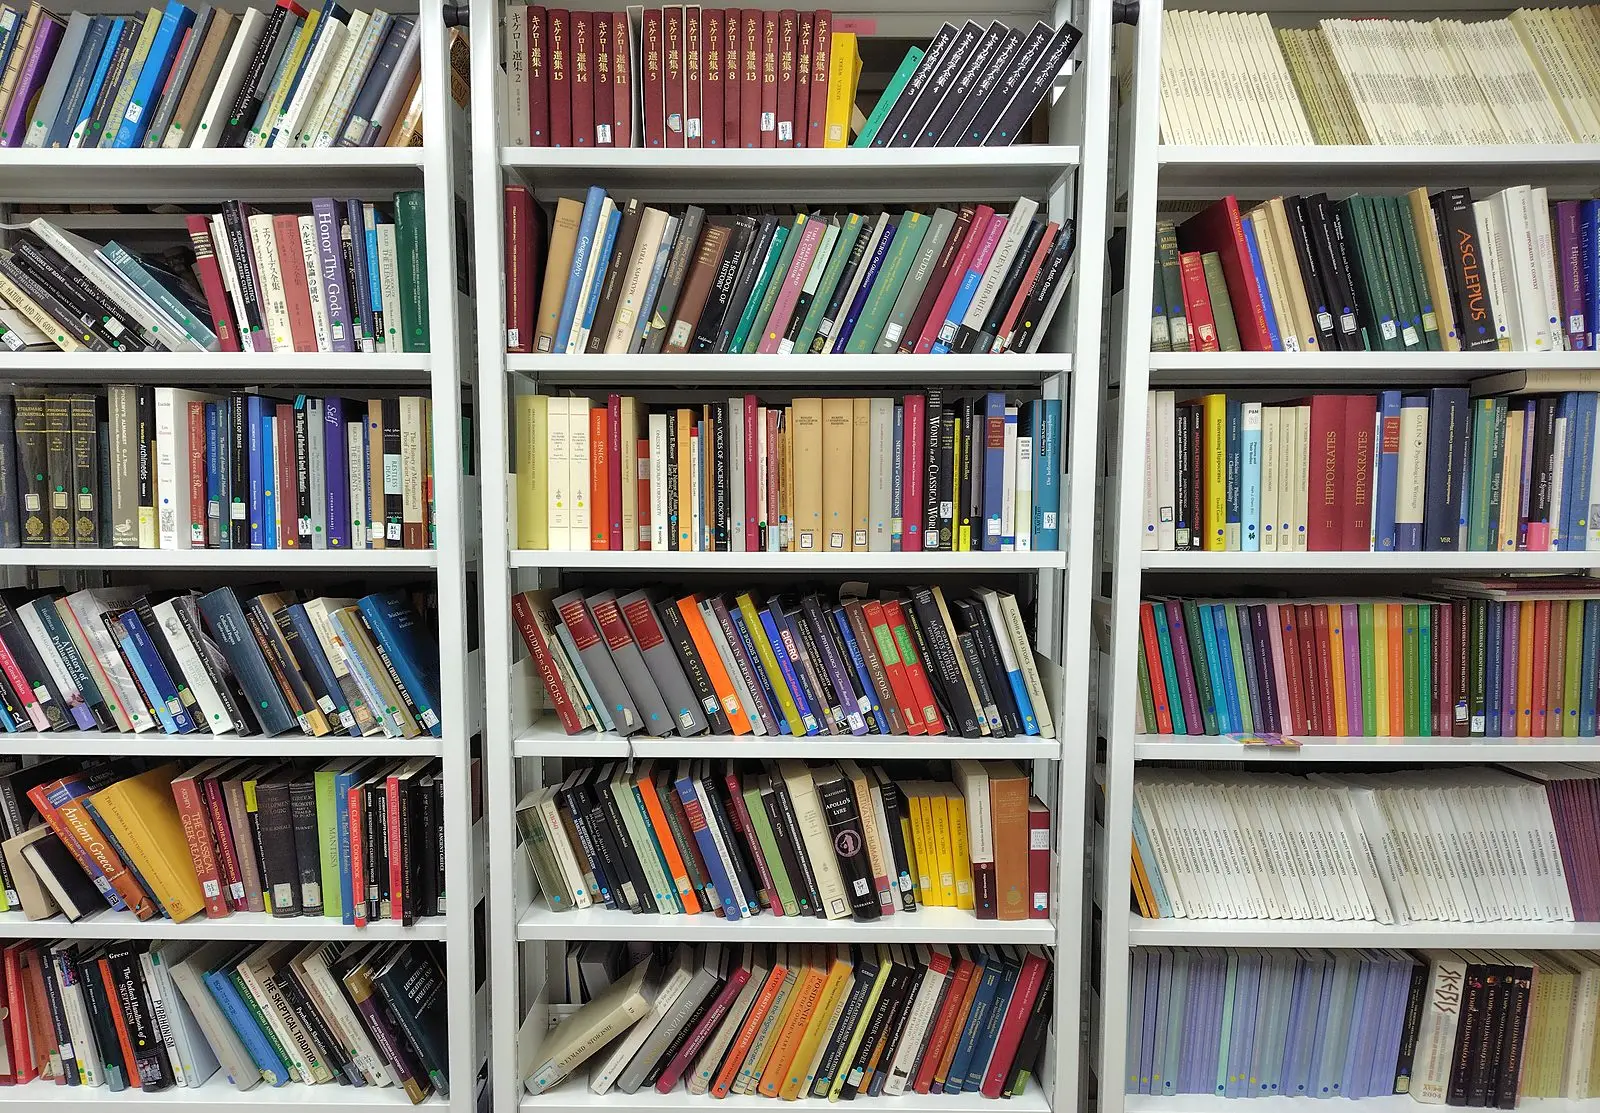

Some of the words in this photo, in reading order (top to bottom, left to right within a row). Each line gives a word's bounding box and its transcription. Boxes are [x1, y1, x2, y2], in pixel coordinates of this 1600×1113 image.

[318, 212, 334, 253] Honor
[21, 243, 46, 268] RELIGIONS
[50, 269, 65, 283] ROME
[321, 251, 337, 280] Thy
[572, 235, 590, 277] Geography
[731, 249, 741, 264] THE
[913, 247, 933, 282] STUDIES
[992, 236, 1014, 275] ANCIENT
[1052, 255, 1062, 269] The
[1570, 245, 1580, 291] Hippocrates
[715, 259, 730, 289] HISTORY
[722, 263, 736, 292] SCHOOL
[964, 273, 976, 291] Irwin
[1046, 268, 1056, 282] Attic
[1456, 227, 1486, 321] ASCLEPIUS
[72, 275, 82, 285] of
[79, 281, 101, 301] Plato's
[98, 297, 126, 324] Academy
[328, 283, 342, 317] Gods
[718, 293, 727, 304] OF
[972, 274, 997, 318] LIBRARIES
[1037, 280, 1051, 302] Orators
[22, 302, 35, 316] AND
[32, 312, 44, 324] THE
[41, 320, 57, 336] GOOD
[325, 404, 337, 426] Self
[929, 416, 939, 447] WOMEN
[717, 450, 723, 459] OF
[1325, 431, 1336, 505] HIPPOKRATES
[1356, 431, 1367, 504] HIPPOKRATES
[927, 464, 938, 505] CLASSICAL
[1538, 483, 1546, 508] Symptoms
[928, 506, 937, 530] WORL
[779, 629, 799, 662] CICERO
[922, 651, 934, 673] SENECA
[929, 619, 945, 650] MARCUS
[940, 649, 958, 684] AURELIUS
[50, 634, 85, 692] Pythagoreanism
[63, 645, 83, 673] History
[78, 670, 88, 682] of
[523, 623, 544, 659] STUDIES
[541, 664, 565, 706] STOICISM
[679, 639, 692, 657] THE
[688, 658, 709, 693] CYNICS
[720, 617, 736, 646] SENECA
[733, 647, 741, 657] IN
[737, 657, 764, 710] PERFORMANCE
[868, 652, 880, 671] THE
[874, 670, 890, 700] STOICS
[191, 811, 202, 829] THE
[826, 797, 850, 810] APOLLO'S
[833, 808, 847, 816] LYRE
[61, 801, 96, 843] Ancient
[88, 839, 118, 874] Greece
[351, 809, 359, 841] CLASSICAL
[856, 784, 873, 833] CULTIVATING
[866, 835, 882, 876] HUMANITY
[180, 813, 195, 842] GREEK
[188, 842, 204, 876] READER
[195, 828, 214, 873] CLASSICAL
[328, 827, 336, 867] MANTISSA
[352, 844, 360, 878] COOKBOOK
[122, 966, 131, 979] The
[767, 968, 784, 993] PLATO'S
[118, 982, 134, 1025] SKEPTICISM
[125, 979, 137, 1000] Oxford
[262, 976, 276, 993] THE
[271, 991, 299, 1032] SKEPTICAL
[760, 991, 772, 1008] FIRST
[774, 989, 785, 1005] From
[796, 976, 823, 1028] POSIDONIUS
[879, 997, 889, 1012] THE
[130, 1001, 144, 1030] Handbook
[153, 998, 174, 1048] PYRRHONISM
[662, 998, 693, 1039] REALIZING
[760, 1014, 774, 1035] Origins
[770, 1004, 778, 1015] the
[870, 1012, 883, 1035] INNER
[137, 1030, 146, 1039] of
[739, 1006, 765, 1050] INTERPRETERS
[747, 1041, 762, 1066] Socrates
[858, 1035, 874, 1065] CITADEL
